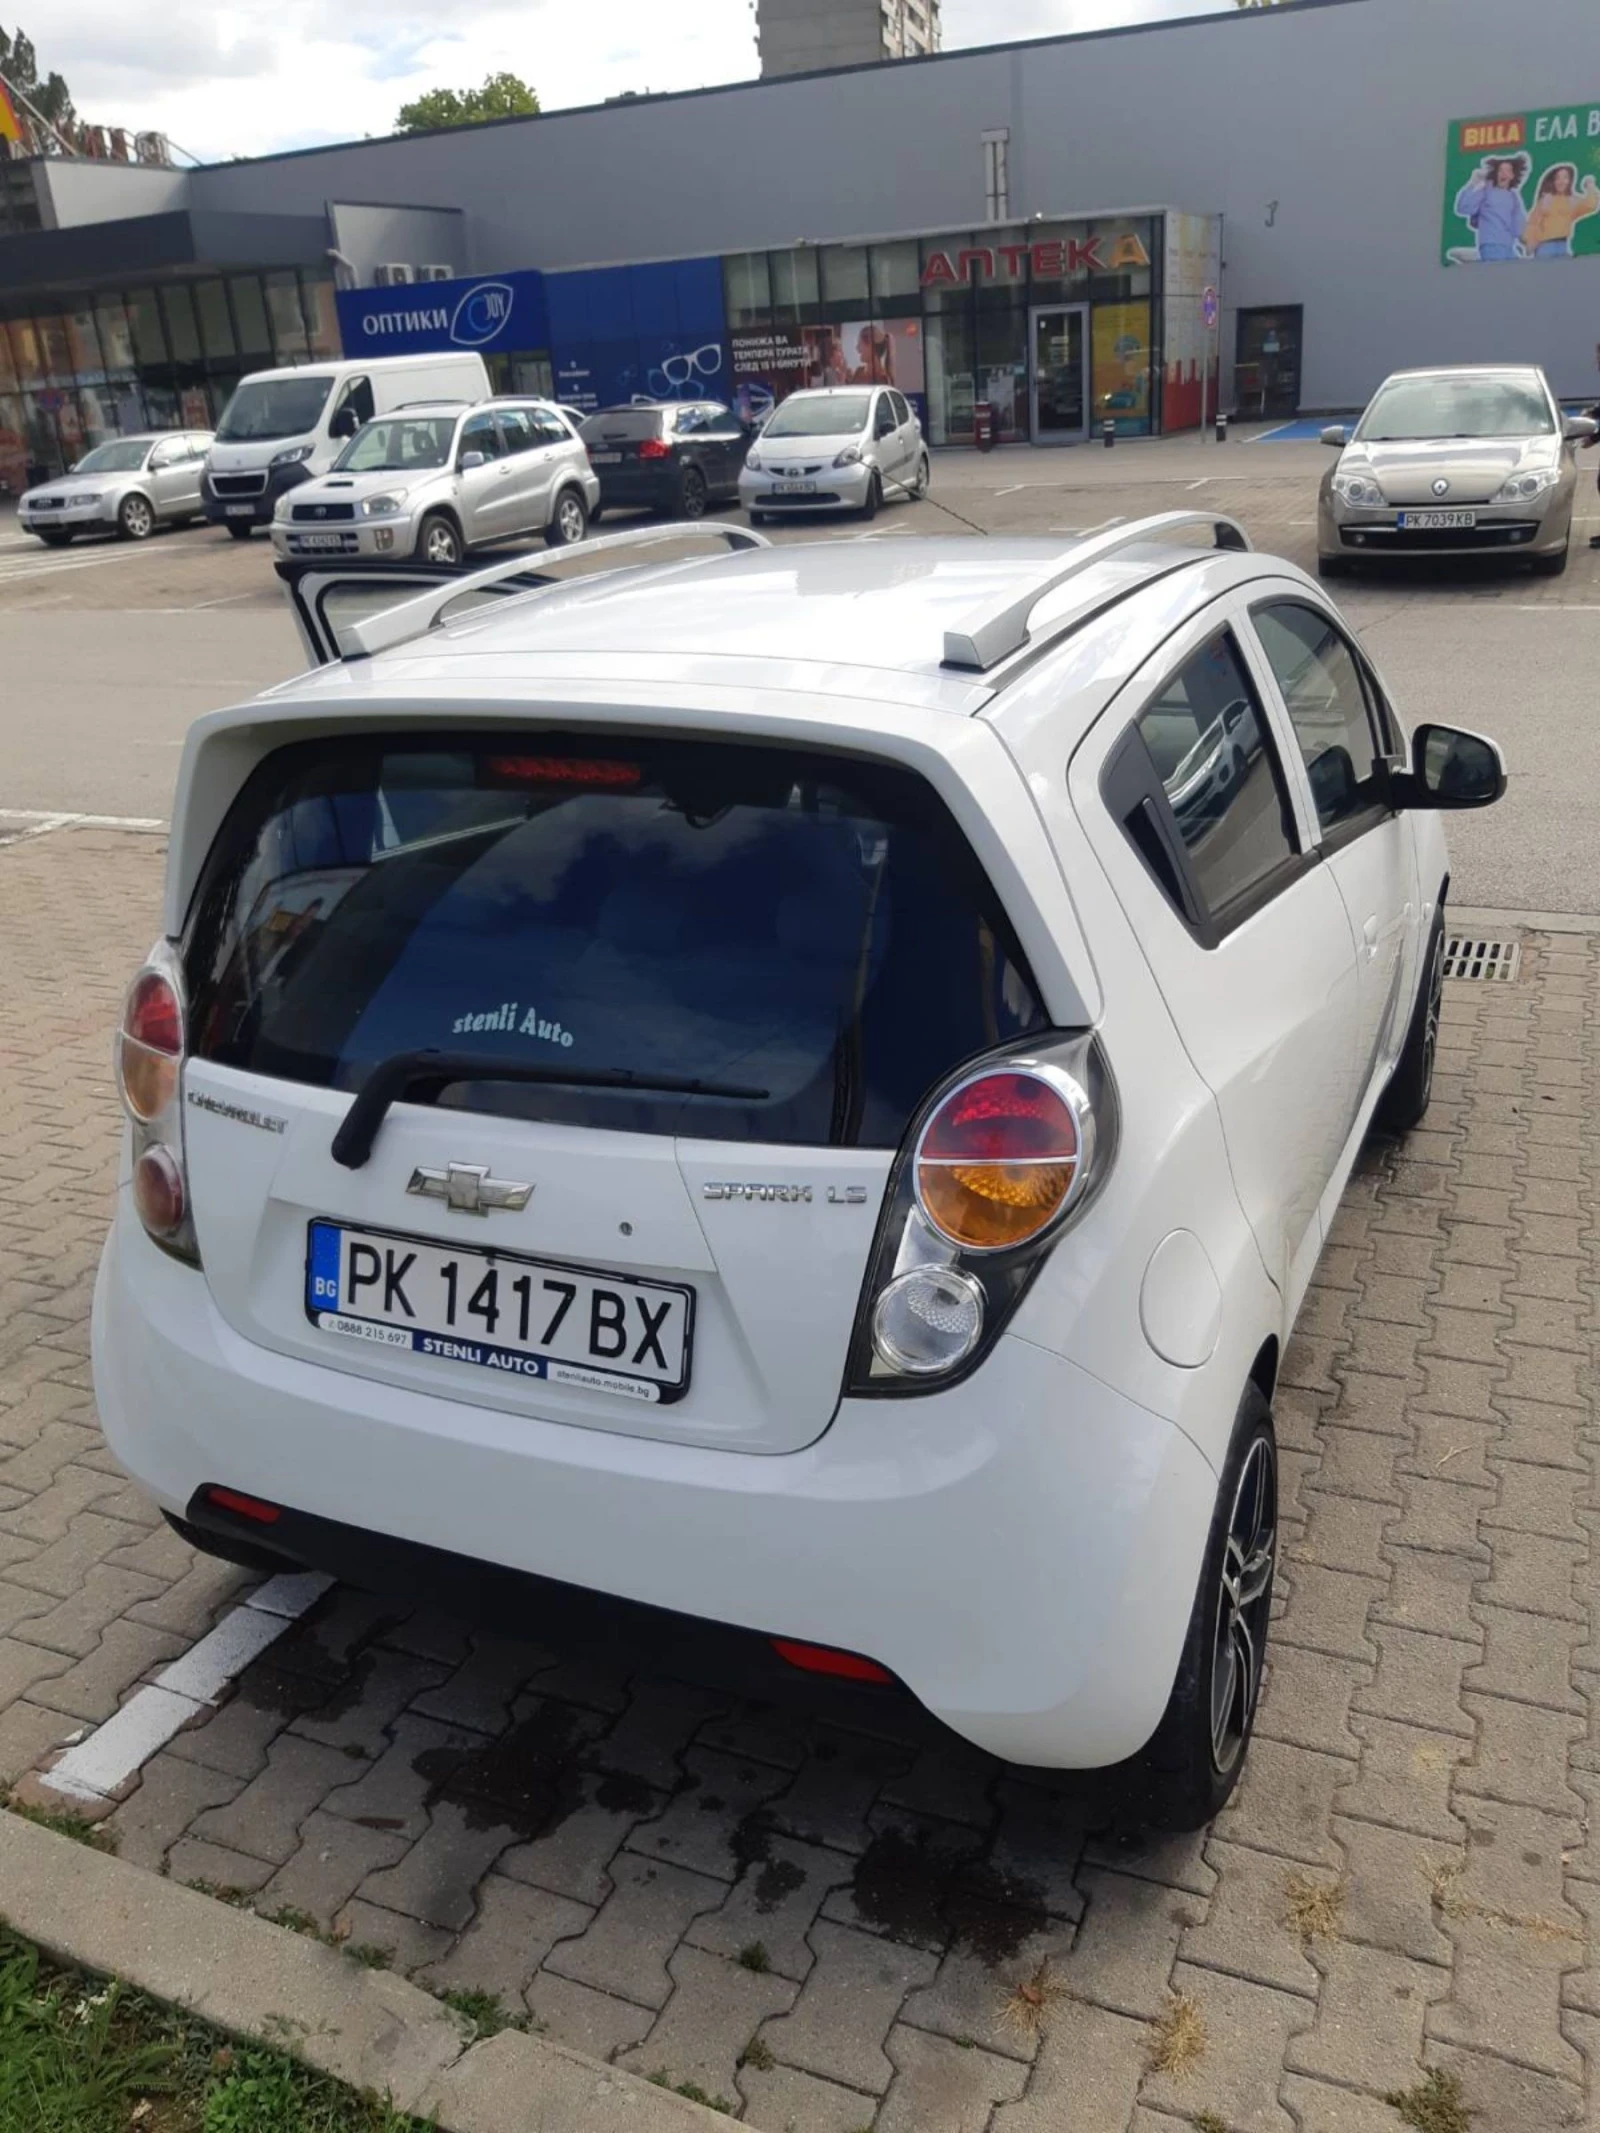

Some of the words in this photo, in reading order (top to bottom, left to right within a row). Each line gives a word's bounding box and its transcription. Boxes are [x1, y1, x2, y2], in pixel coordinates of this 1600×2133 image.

[1464, 123, 1520, 148] BILLA
[1535, 114, 1578, 142] ЕЛА
[920, 233, 1151, 288] АПТЕКА
[363, 308, 448, 335] ОПТИКИ
[1406, 515, 1422, 526] PK
[1424, 513, 1455, 526] 7039
[452, 1002, 518, 1034] stenli
[519, 1007, 573, 1047] Auto
[703, 1182, 813, 1203] SPARK
[827, 1186, 868, 1204] LS
[315, 1276, 337, 1298] BG
[347, 1242, 418, 1318] PK
[440, 1261, 577, 1345] 1417
[588, 1288, 672, 1370] BX
[337, 1320, 362, 1336] 0888
[365, 1327, 385, 1341] 215
[387, 1332, 408, 1345] 697
[423, 1338, 481, 1363] STENLI
[486, 1353, 539, 1375] AUTO
